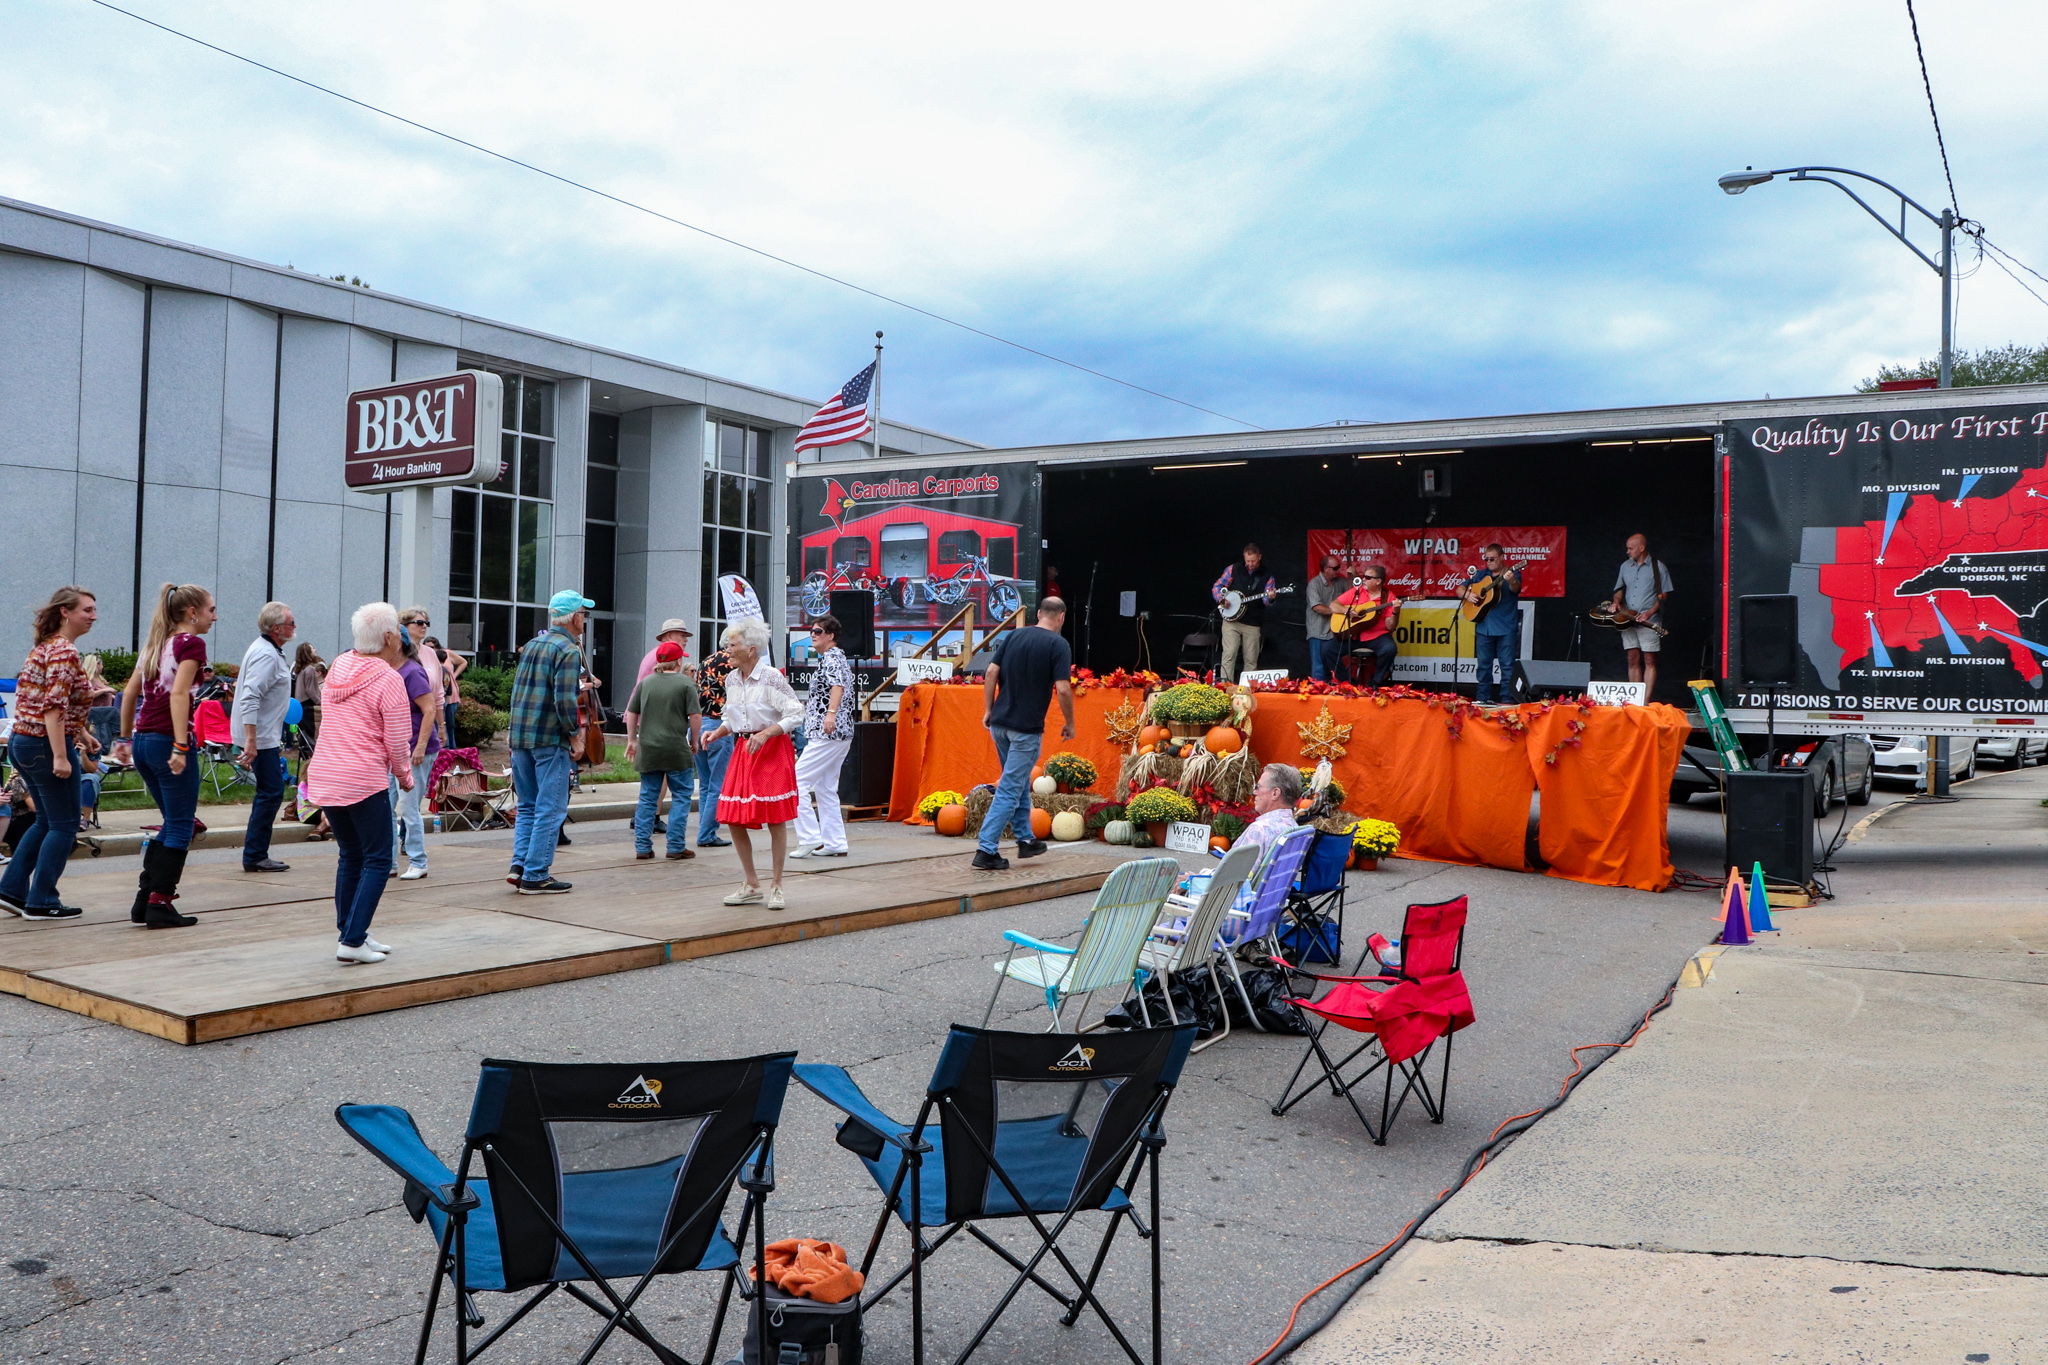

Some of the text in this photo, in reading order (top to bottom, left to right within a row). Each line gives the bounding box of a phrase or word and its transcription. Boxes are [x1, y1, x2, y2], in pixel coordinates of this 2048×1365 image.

[354, 383, 465, 454] BB&T
[1751, 418, 1849, 456] Quality
[1856, 420, 1882, 443] Is
[1889, 419, 1945, 441] Our
[1951, 414, 2026, 440] First
[372, 461, 442, 480] 24 Hour Banking
[1941, 466, 2019, 476] IN. DIVISION
[851, 472, 999, 499] Carolina Carports
[1861, 483, 1940, 493] MO. DIVISION
[1329, 548, 1356, 557] 10,00
[1404, 538, 1459, 555] WPAQ
[1510, 553, 1547, 561] CHANNEL
[1387, 573, 1422, 590] making
[1438, 572, 1466, 590] differ
[1396, 621, 1450, 644] olina
[1393, 663, 1429, 672] cat.com
[1925, 657, 2006, 666] MS. DIVISION
[907, 663, 943, 676] WPAQ
[1850, 669, 1925, 678] TX. DIVISION
[1595, 685, 1638, 698] WPAQ
[1737, 693, 1747, 706] 7
[1834, 695, 1858, 709] TO
[1862, 696, 1919, 710] SERVE
[1922, 697, 1962, 711] OUR
[1966, 699, 2048, 713] CUSTOM
[1172, 824, 1205, 842] WPAQ
[616, 1095, 652, 1103] GCI
